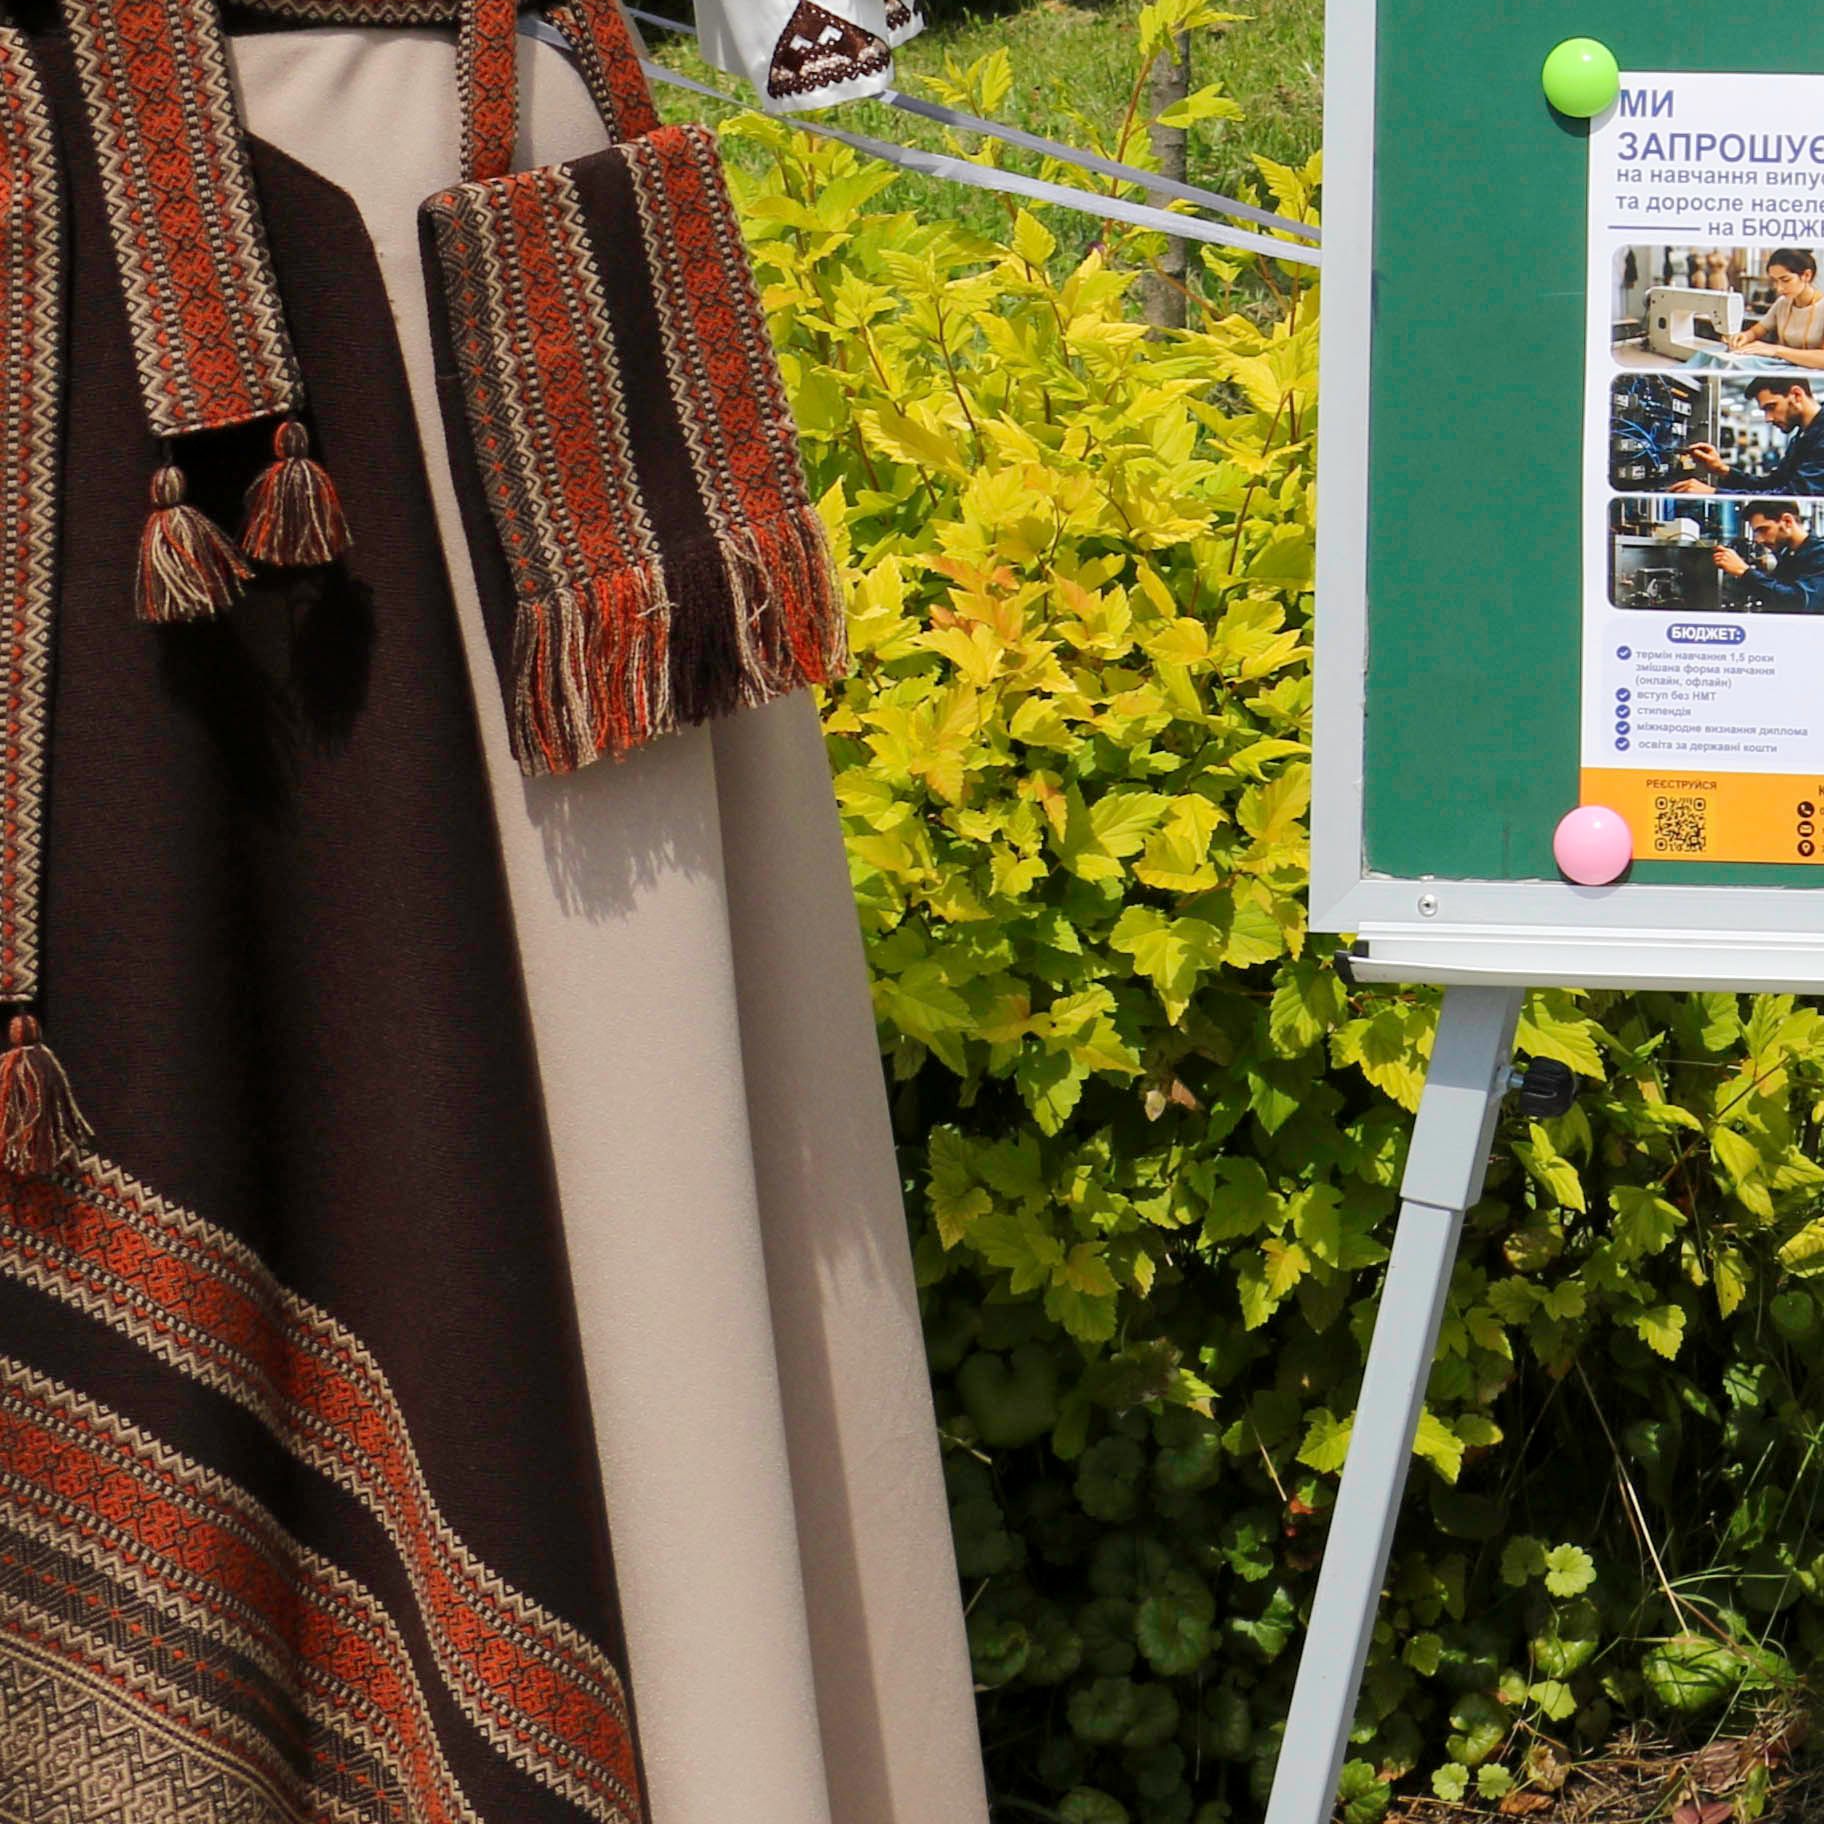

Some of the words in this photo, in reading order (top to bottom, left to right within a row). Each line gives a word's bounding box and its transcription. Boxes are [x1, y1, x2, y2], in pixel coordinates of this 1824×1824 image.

[1620, 89, 1675, 119] МИ
[1617, 169, 1643, 184] на
[1650, 169, 1758, 185] навчання
[1616, 194, 1639, 211] та
[1646, 195, 1744, 216] доросле
[1708, 220, 1734, 236] на
[1671, 627, 1741, 642] БЮДЖЕТ:
[1646, 778, 1718, 791] РЕЄСТРУЙСЯ
